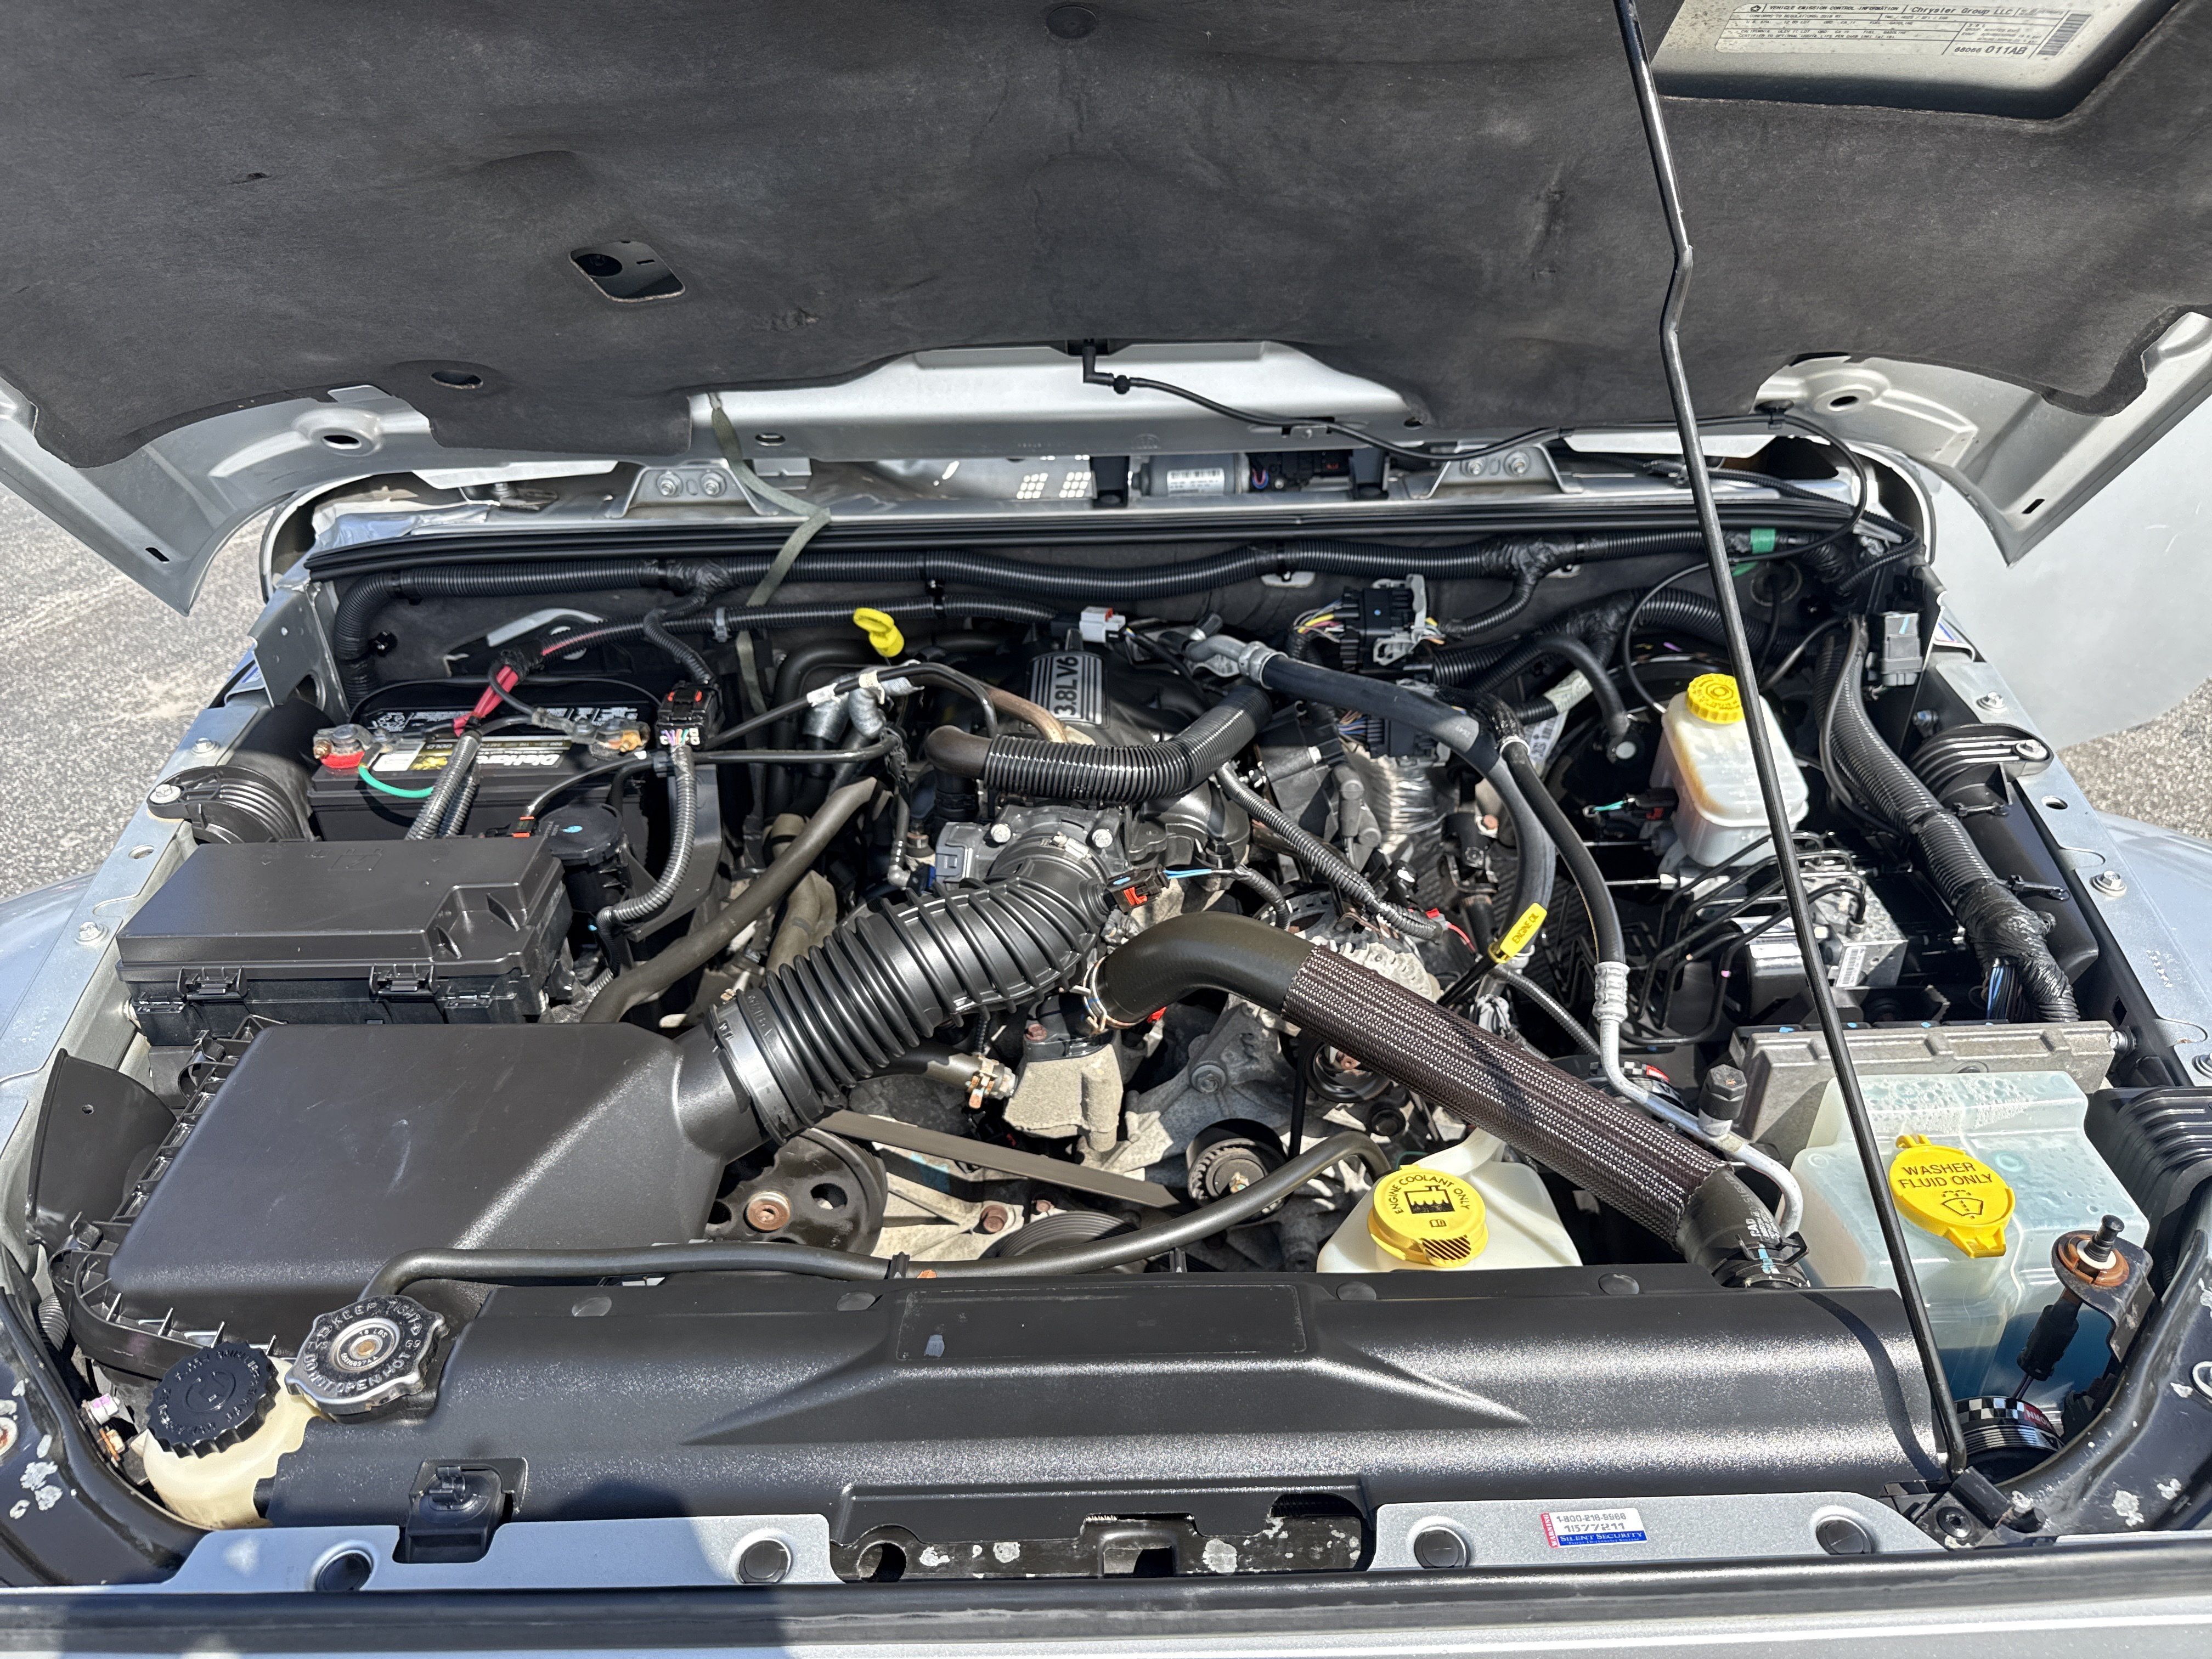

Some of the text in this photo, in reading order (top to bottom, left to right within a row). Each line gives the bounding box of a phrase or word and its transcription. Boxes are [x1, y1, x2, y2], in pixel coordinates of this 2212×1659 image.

[1053, 656, 1079, 715] 3.8L V6
[1898, 1173, 1993, 1189] FLUID ONLY
[1901, 1162, 1977, 1176] WASHER
[1388, 1175, 1471, 1215] ENGINE COOLANT ONLY
[331, 1301, 378, 1329] KEEP
[1543, 1514, 1558, 1547] WARNING
[1560, 1532, 1643, 1542] SILENT SECURITY
